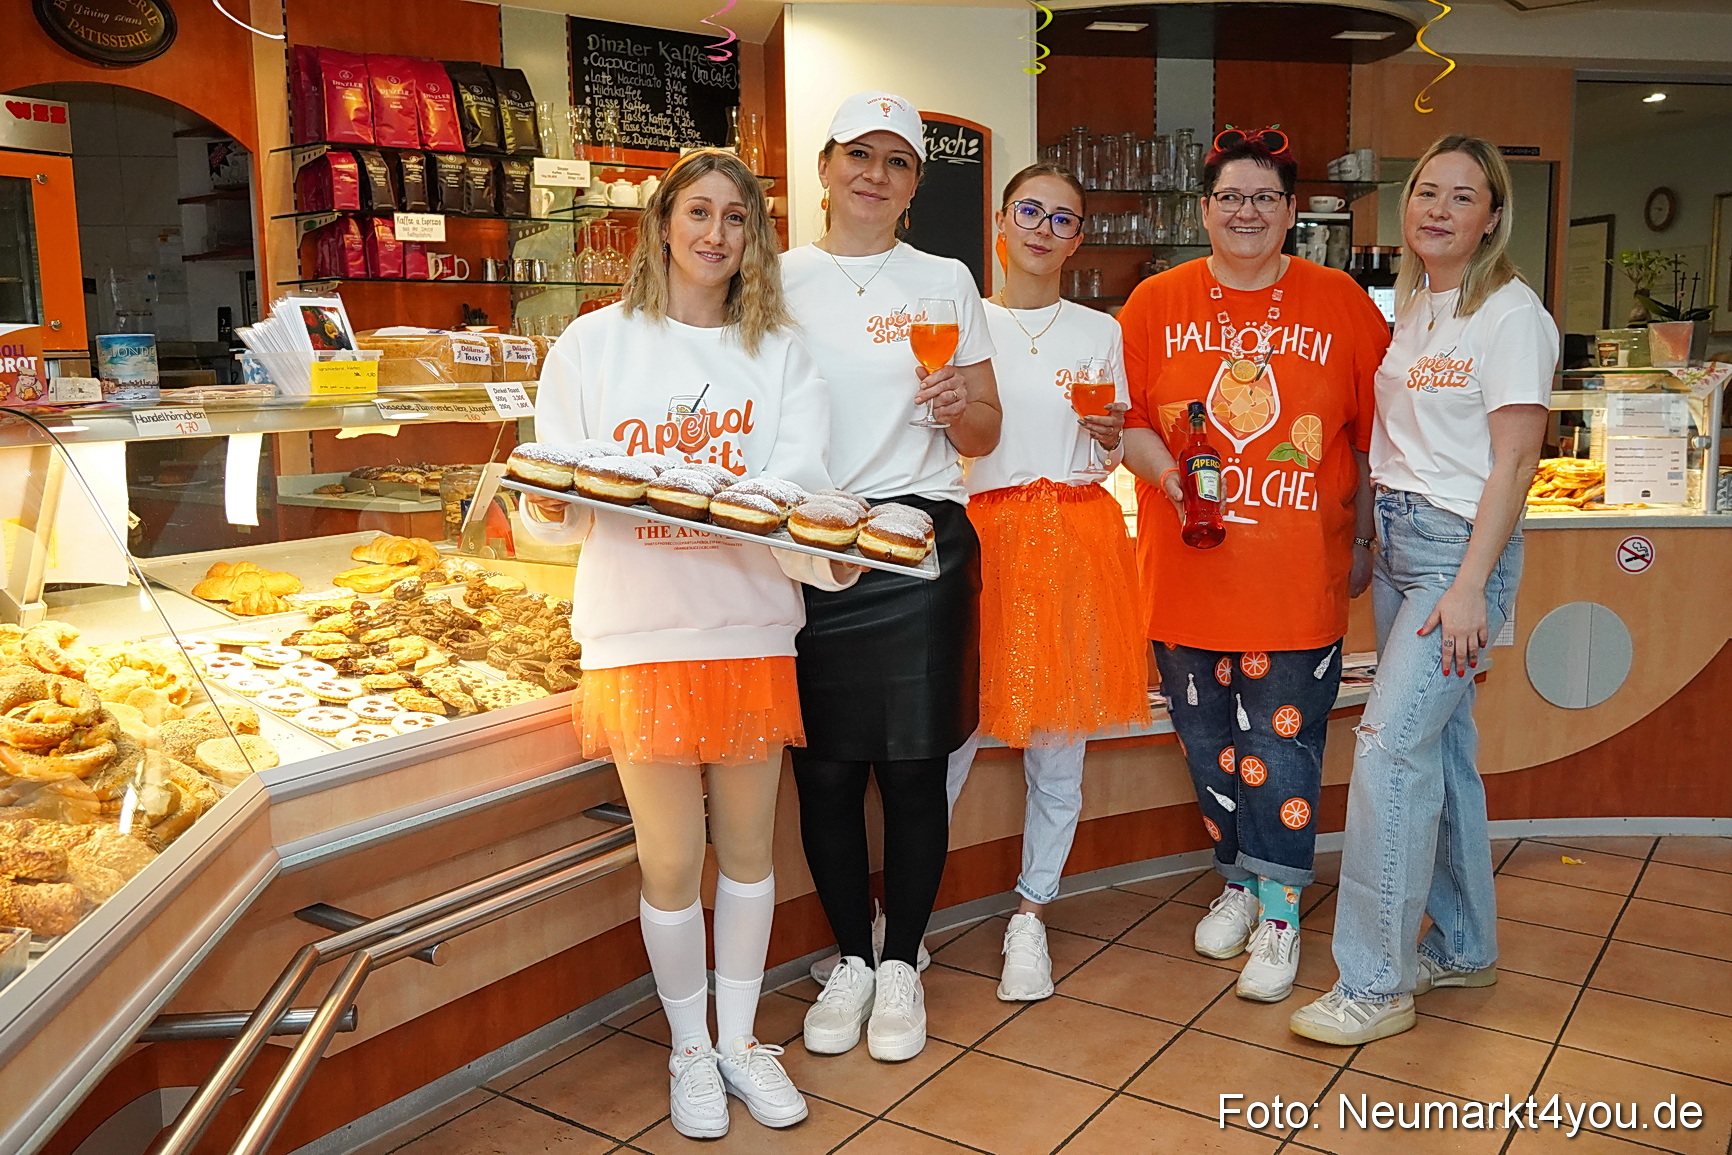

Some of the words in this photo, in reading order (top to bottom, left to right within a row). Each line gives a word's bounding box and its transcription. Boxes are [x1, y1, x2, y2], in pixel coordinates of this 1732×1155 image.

[67, 17, 152, 48] PATISSERIE
[587, 34, 652, 57] Dinzler
[659, 41, 710, 70] Kaffe
[590, 52, 655, 77] Cappuccino
[664, 62, 687, 80] 3,40€
[332, 79, 363, 89] DINZLER
[380, 88, 409, 96] DINZLER
[617, 73, 662, 88] Macchiato
[665, 79, 688, 94] 3,40€
[466, 94, 496, 104] DINZLER
[504, 99, 535, 107] DINZLER
[592, 84, 643, 101] Milchkaffee
[665, 91, 688, 107] 3,50€
[593, 95, 620, 109] Tasse
[622, 99, 651, 115] Kaffee
[621, 110, 646, 123] Tasse
[648, 112, 672, 126] Kaffee
[620, 120, 640, 132] Tasse
[641, 122, 678, 138] Schokolade
[680, 128, 701, 140] 3,50€
[922, 124, 980, 161] risch:
[396, 215, 414, 226] Kaffee
[866, 310, 928, 332] Aperol
[873, 325, 911, 344] Spri
[1165, 321, 1332, 366] HALLÖCHEN
[0, 344, 24, 357] OLI
[1406, 370, 1469, 392] Spritz
[134, 410, 206, 423] Mandelhörnchen
[613, 398, 755, 457] Aperol
[1192, 458, 1221, 470] APERO
[1222, 457, 1318, 511] ÖLCHE
[634, 525, 672, 540] THE
